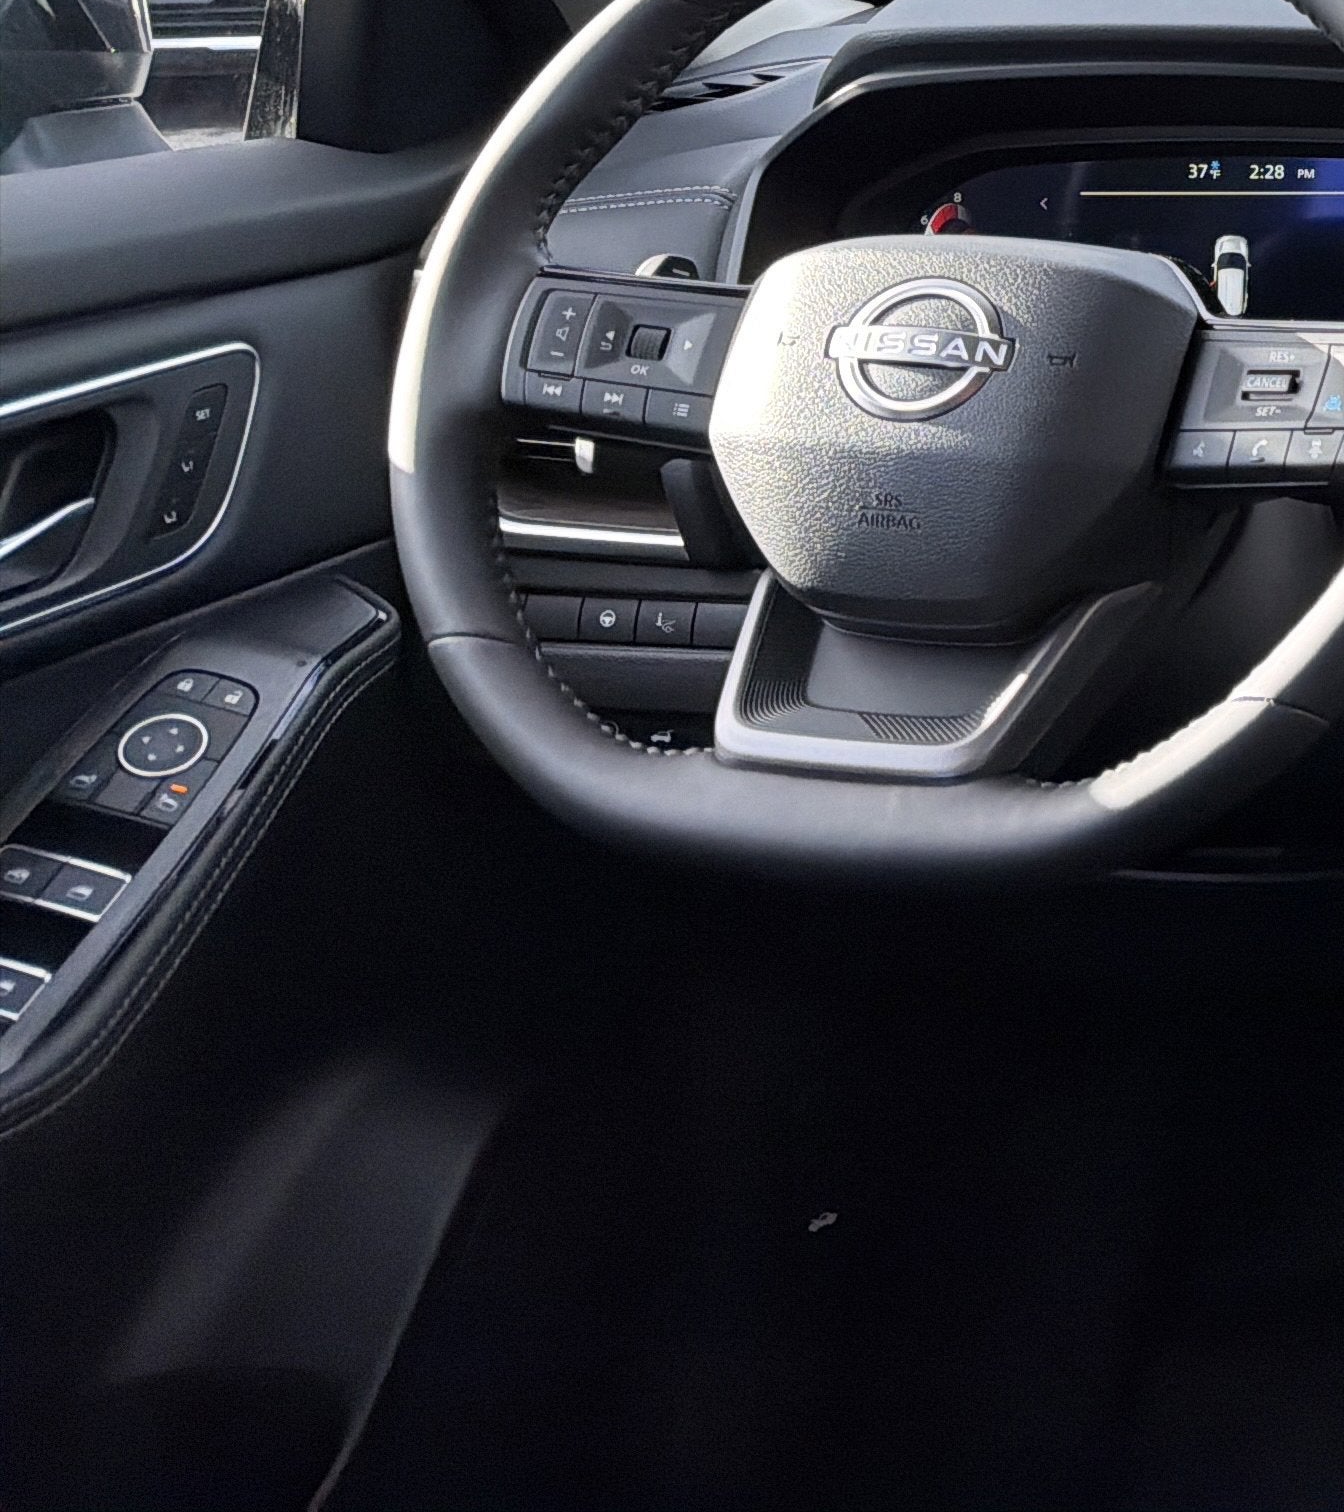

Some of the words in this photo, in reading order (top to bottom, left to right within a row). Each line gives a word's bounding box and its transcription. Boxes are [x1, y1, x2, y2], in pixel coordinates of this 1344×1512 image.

[1249, 164, 1285, 180] 2:28
[1297, 169, 1315, 179] PM
[953, 192, 962, 203] 8
[920, 214, 929, 226] 6
[838, 330, 1009, 366] NISSAN
[630, 365, 650, 376] OK
[1246, 375, 1287, 388] CANCEL
[195, 408, 211, 421] SET
[858, 512, 921, 529] AIRBAG
